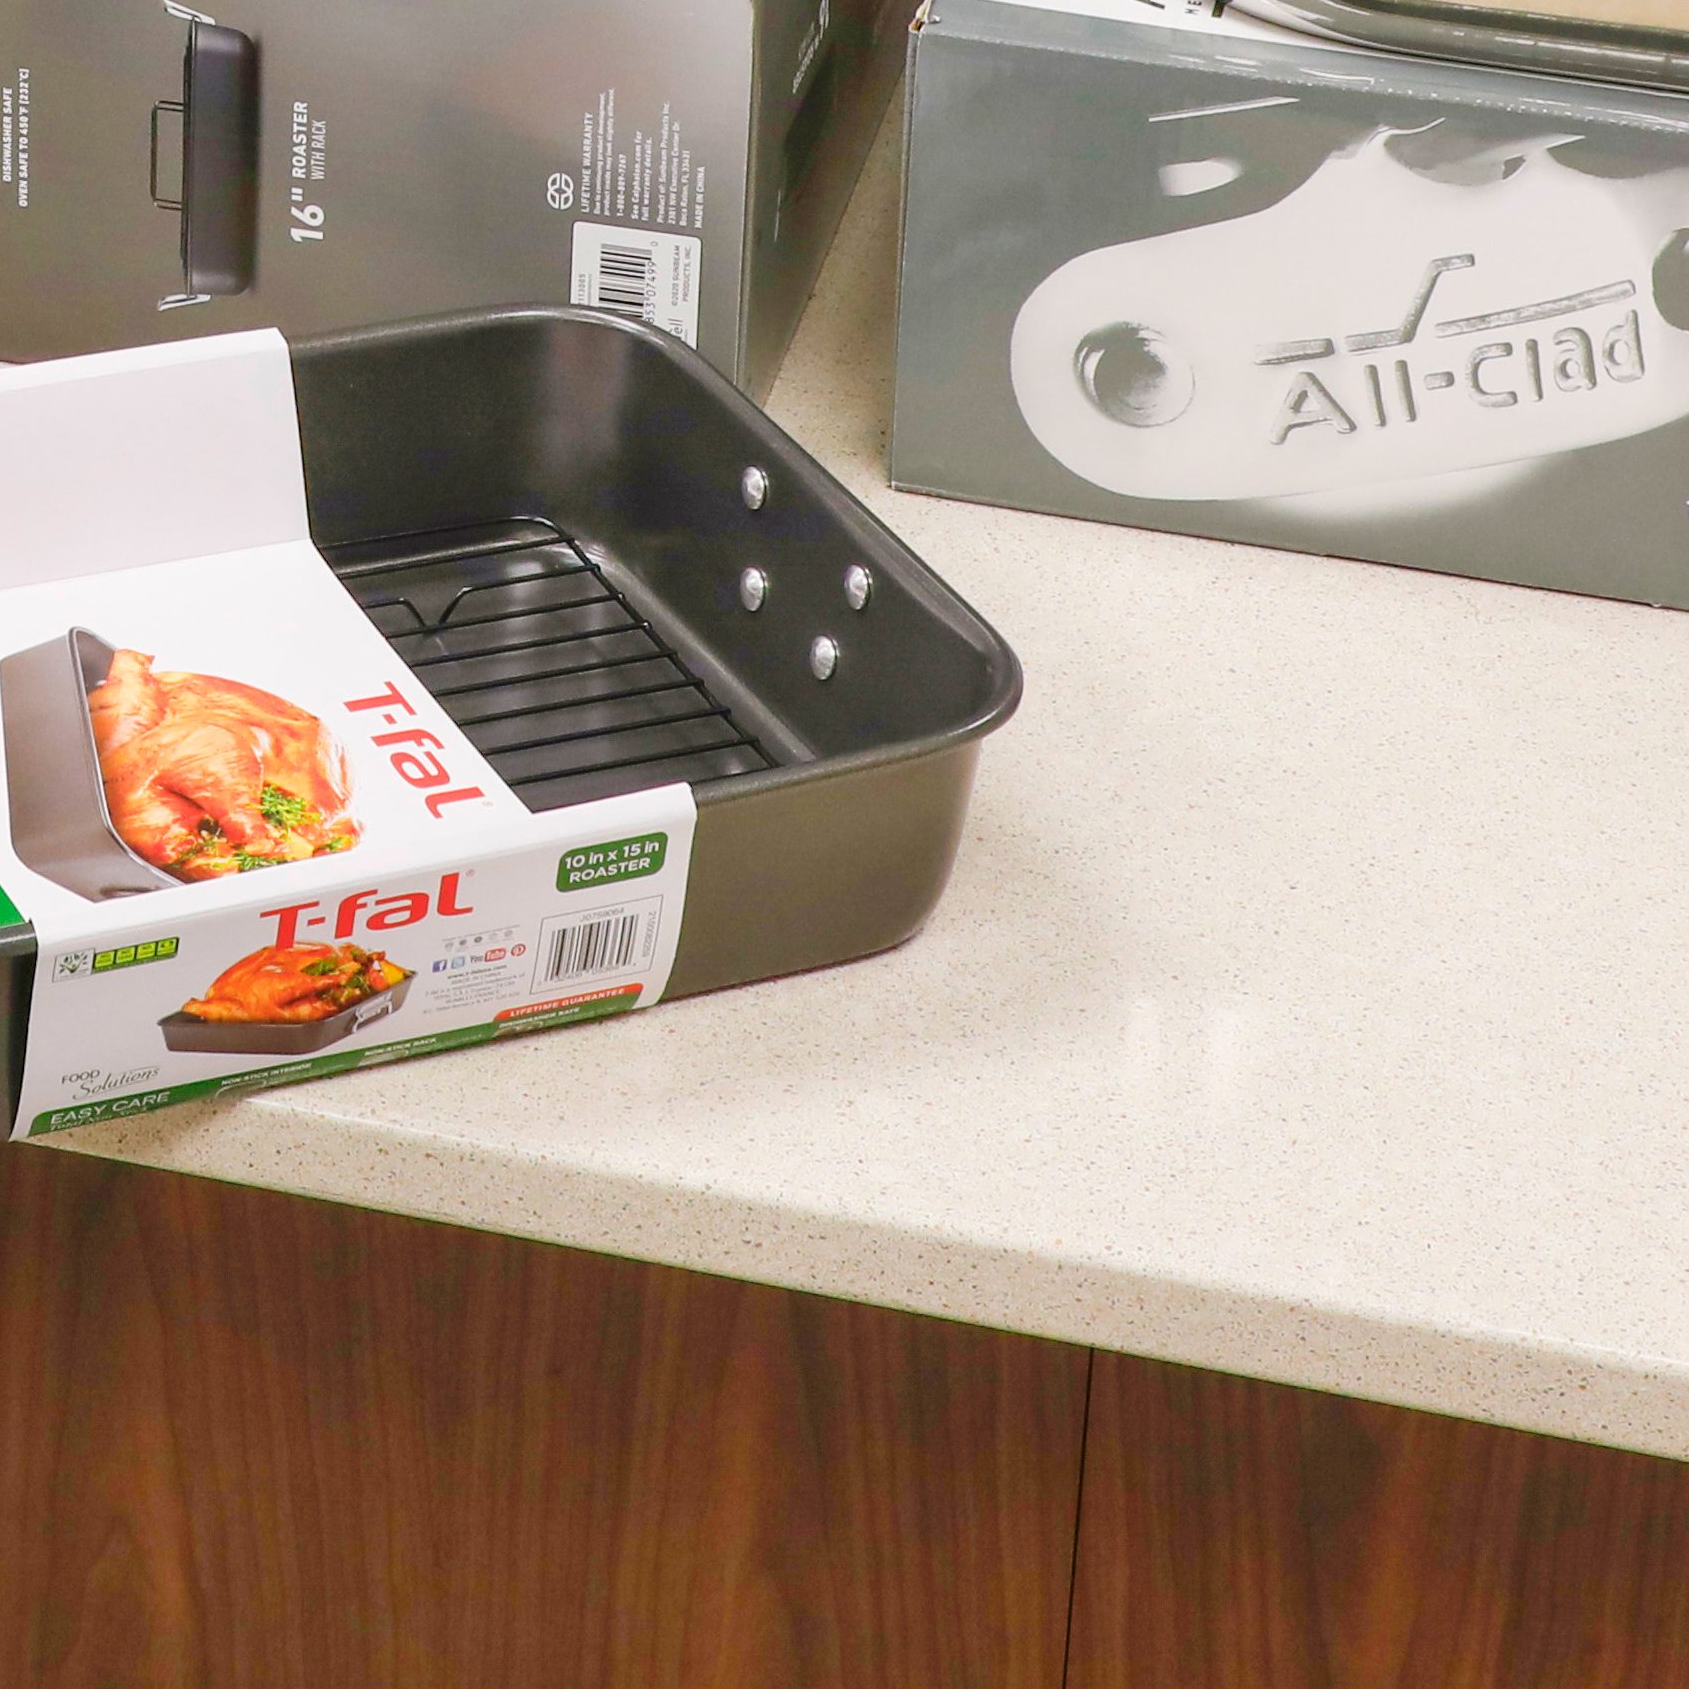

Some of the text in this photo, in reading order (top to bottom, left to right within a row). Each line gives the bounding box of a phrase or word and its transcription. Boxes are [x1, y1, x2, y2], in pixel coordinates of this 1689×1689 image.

[2, 87, 13, 182] DISHWASHER SAFE
[19, 137, 29, 150] TO
[292, 101, 308, 179] ROASTER
[310, 119, 327, 180] WITH RACK
[19, 152, 29, 178] SAFE
[581, 112, 594, 213] LIFETIME WARRANTY
[18, 180, 29, 207] OVEN
[696, 167, 706, 192] CHINA
[290, 187, 325, 242] 16"
[694, 207, 704, 228] MADE
[646, 260, 657, 297] 07499
[1270, 309, 1645, 447] All-Clad
[342, 680, 485, 820] T-fal
[565, 841, 659, 869] 10 in x 15 in
[569, 857, 651, 884] ROASTER
[259, 872, 474, 951] T-fal
[510, 988, 625, 1017] LIFETIME GUARANTEE
[61, 1069, 100, 1085] FOOD
[73, 1067, 160, 1100] Solutions
[50, 1103, 108, 1125] EASY
[112, 1091, 170, 1110] CARE
